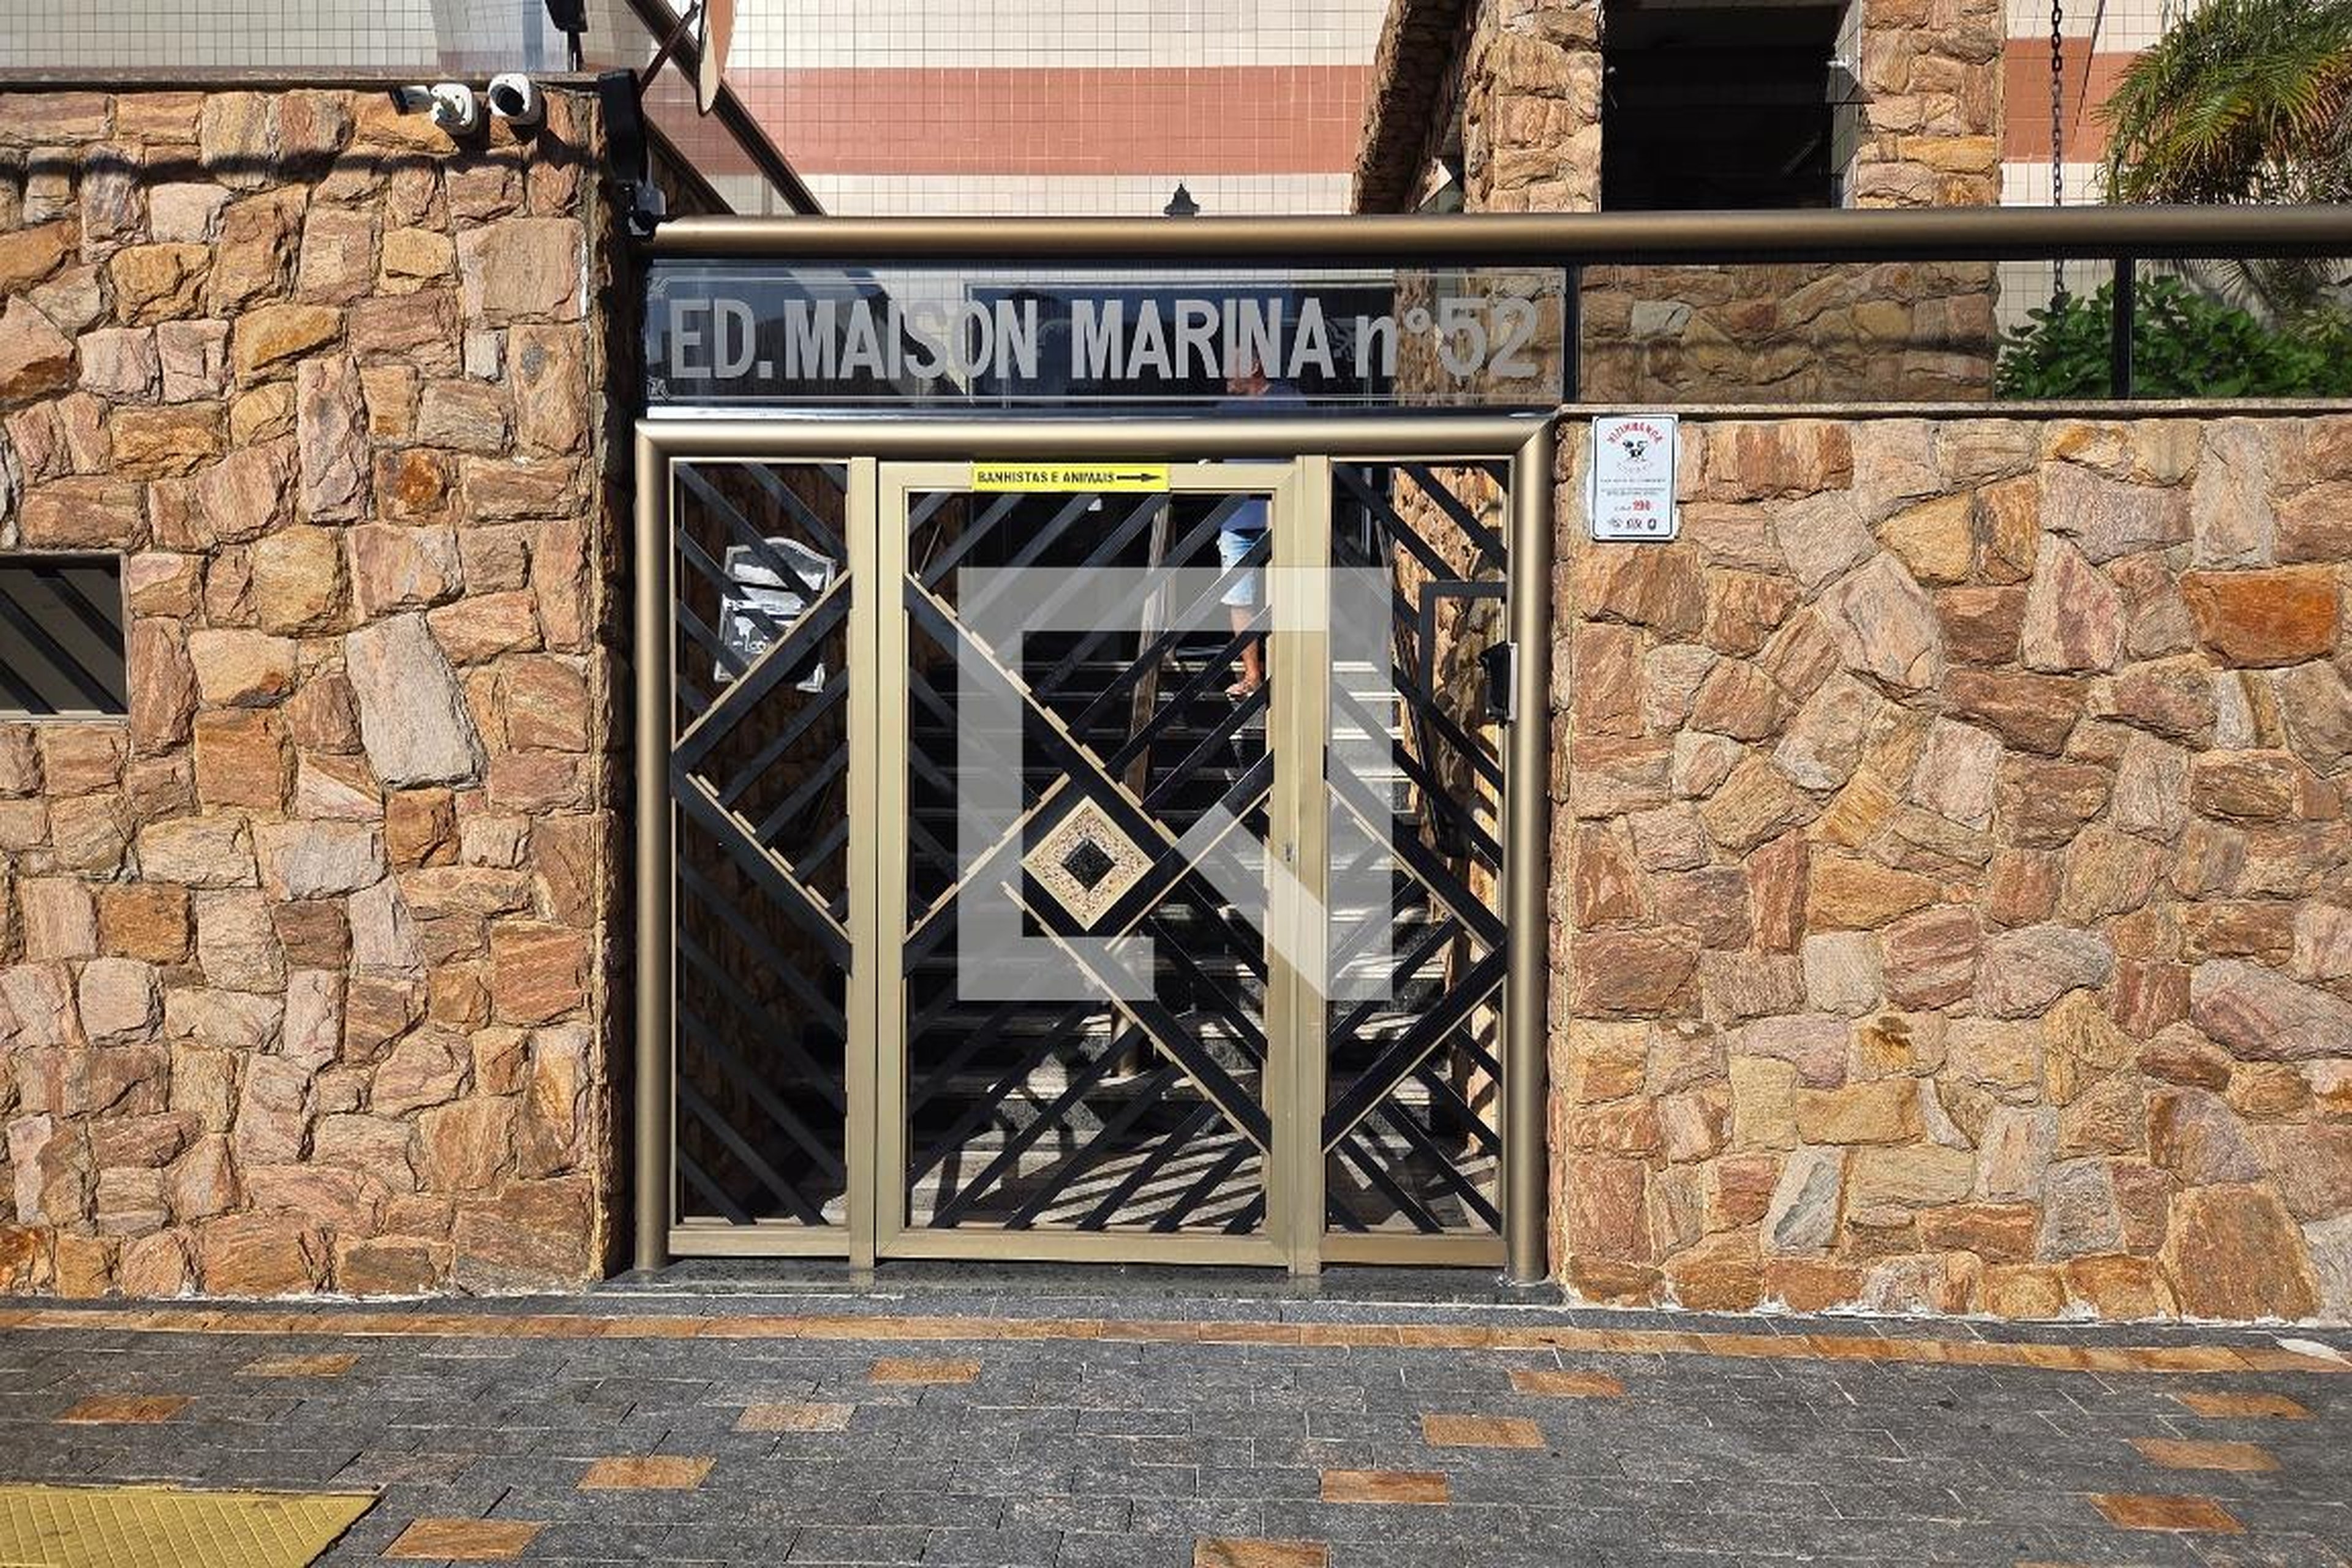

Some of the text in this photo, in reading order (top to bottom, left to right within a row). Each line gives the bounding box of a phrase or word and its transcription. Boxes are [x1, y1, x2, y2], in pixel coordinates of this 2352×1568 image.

[669, 299, 773, 379] ED.
[783, 299, 1038, 379] MAISON
[1071, 298, 1336, 379] MARINA
[978, 471, 1115, 483] BANHISTAS E ANIMAIS
